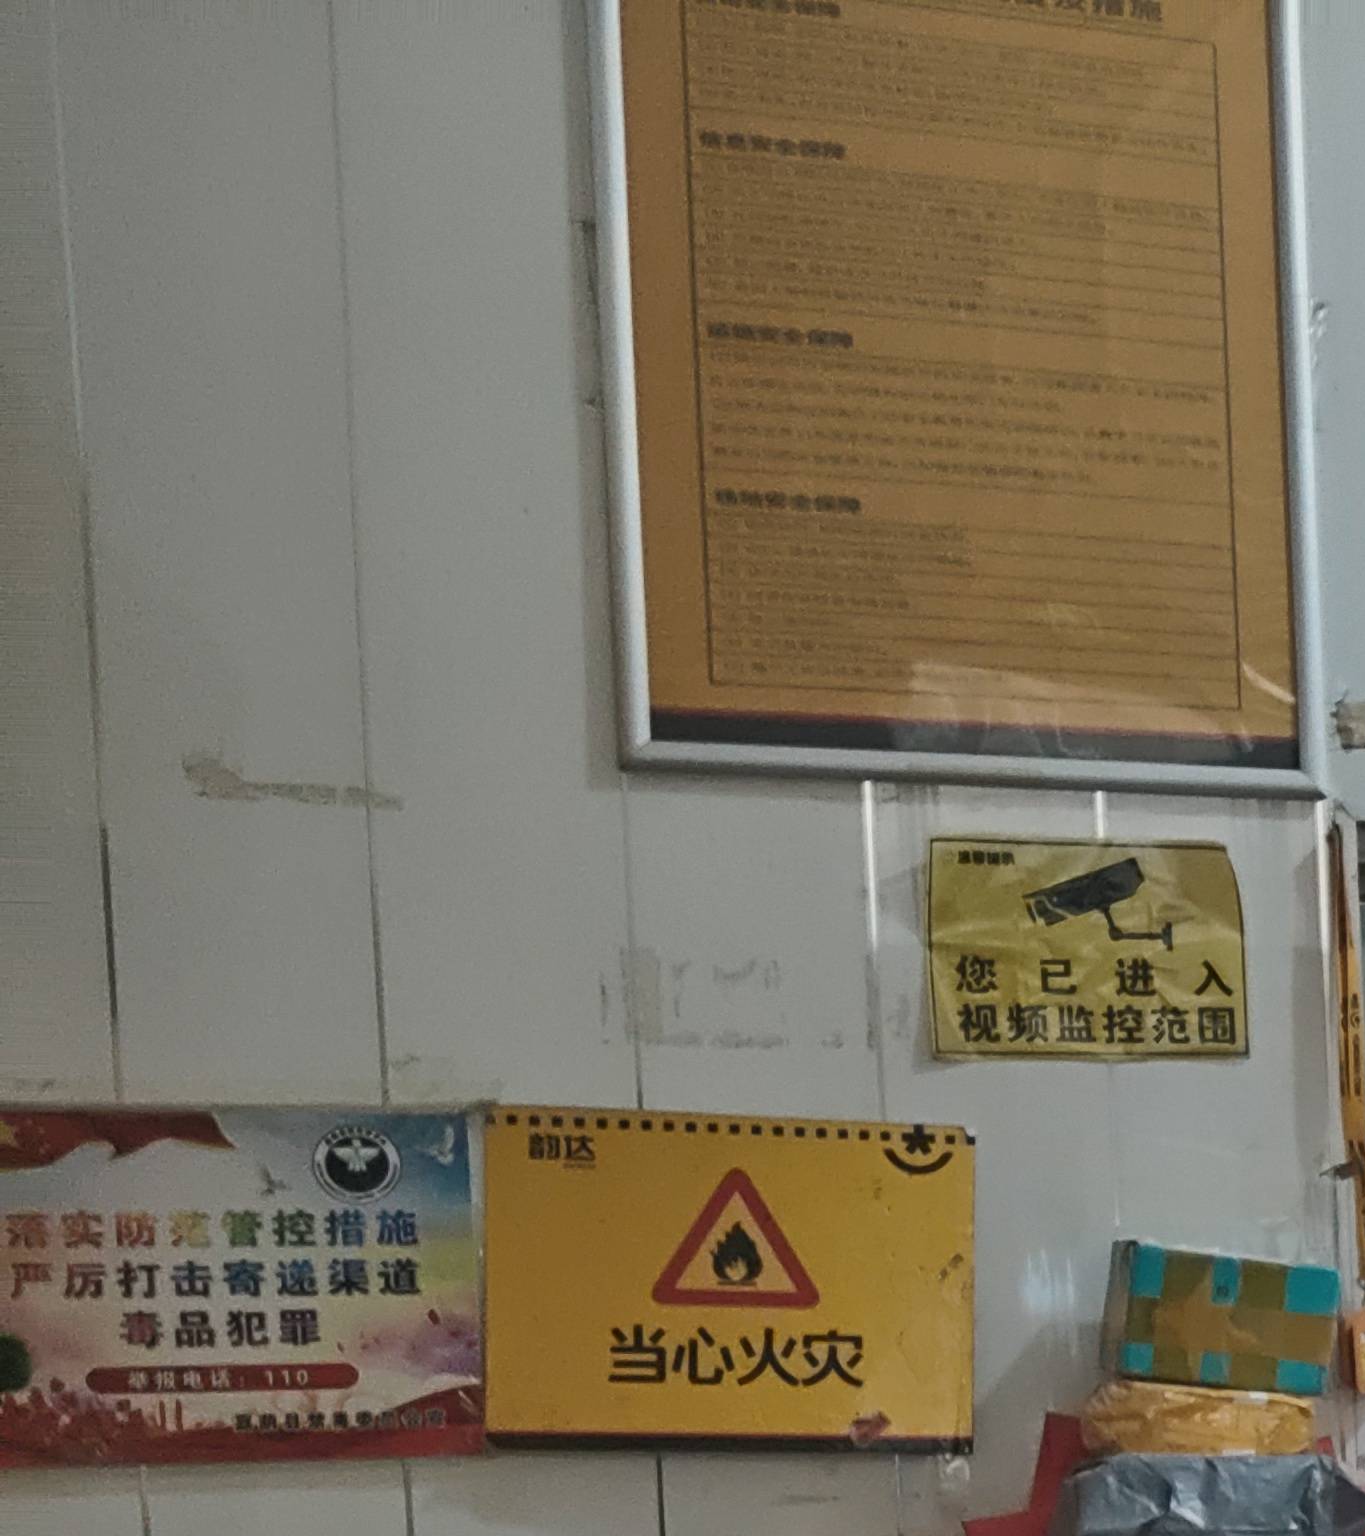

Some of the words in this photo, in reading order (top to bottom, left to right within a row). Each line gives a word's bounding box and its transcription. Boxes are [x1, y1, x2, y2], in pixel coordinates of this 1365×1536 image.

[955, 954, 1234, 998] 您已进入
[957, 1002, 1238, 1046] 视频监控范围
[528, 1132, 596, 1162] 韵达
[5, 1208, 420, 1249] 落实防范管控措施
[10, 1258, 422, 1299] 严厉打击寄递渠道
[119, 1308, 322, 1349] 毒品犯罪
[607, 1323, 864, 1388] 当心火灾
